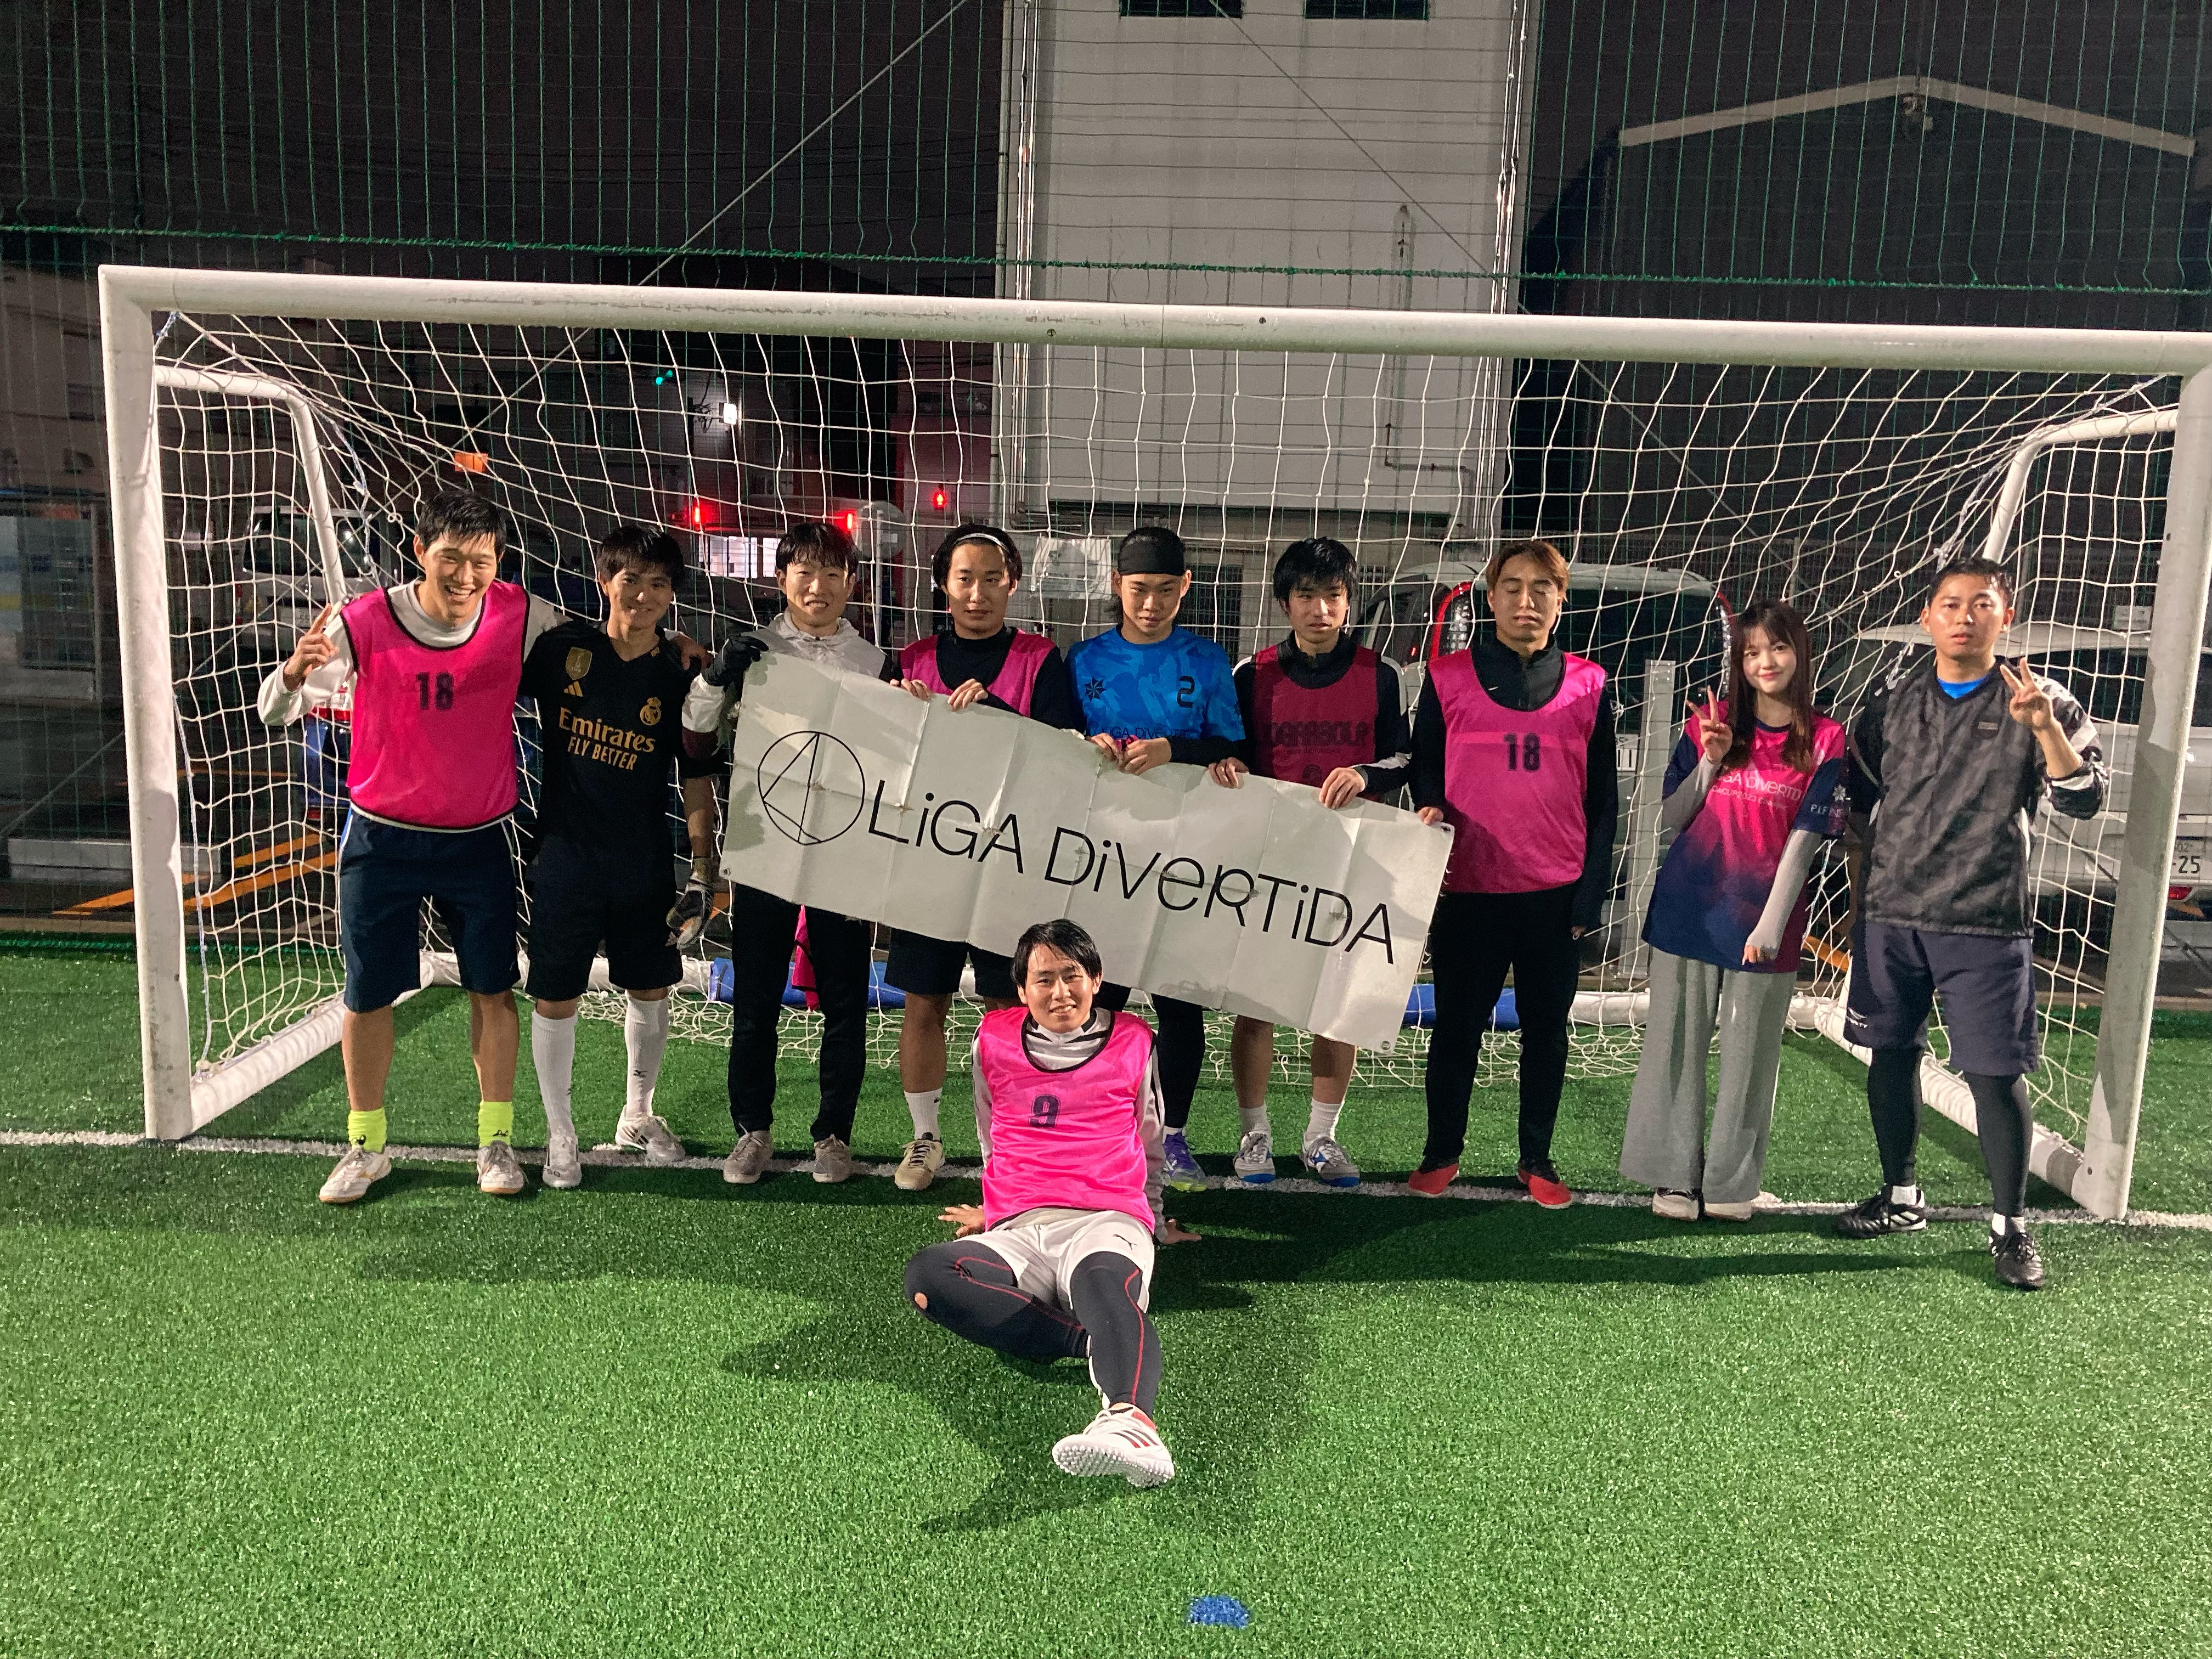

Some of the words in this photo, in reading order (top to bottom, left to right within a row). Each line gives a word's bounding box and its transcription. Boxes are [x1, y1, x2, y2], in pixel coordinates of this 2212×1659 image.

[415, 671, 455, 711] 18
[1177, 675, 1195, 709] 2
[558, 706, 656, 753] Emirates
[567, 736, 590, 757] FLY
[591, 743, 638, 771] BETTER
[1503, 732, 1541, 772] 18
[1029, 1093, 1060, 1128] 9
